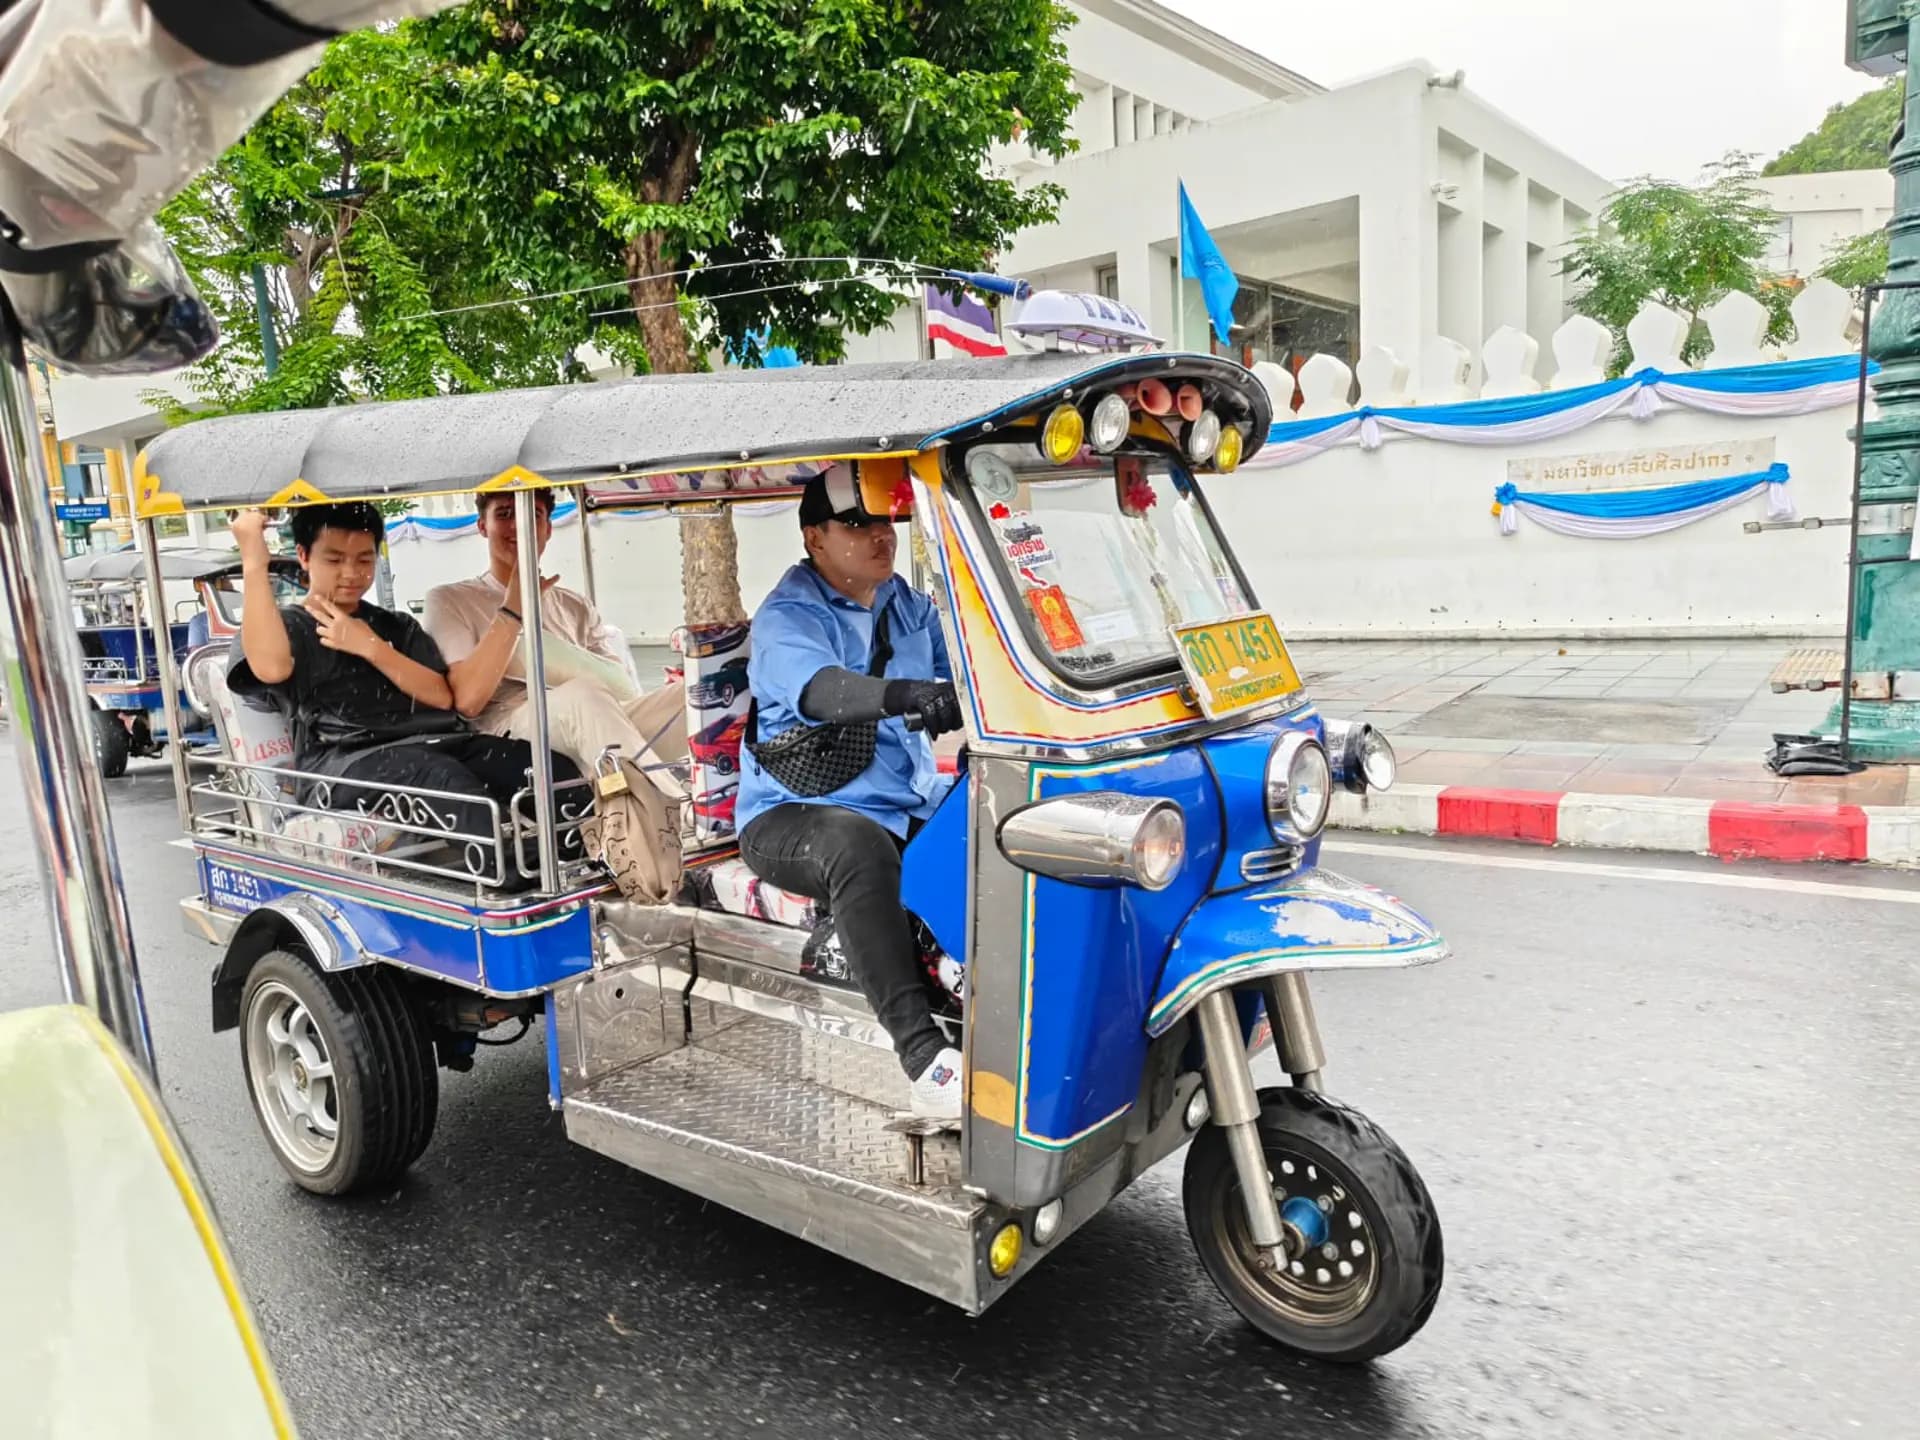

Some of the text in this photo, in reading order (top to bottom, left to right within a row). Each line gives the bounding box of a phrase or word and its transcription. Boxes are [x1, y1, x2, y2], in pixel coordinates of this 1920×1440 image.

[1544, 452, 1731, 480] มหาวิทยาลัยศิลปากร
[1225, 622, 1282, 666] 1451
[230, 872, 261, 899] 1451
